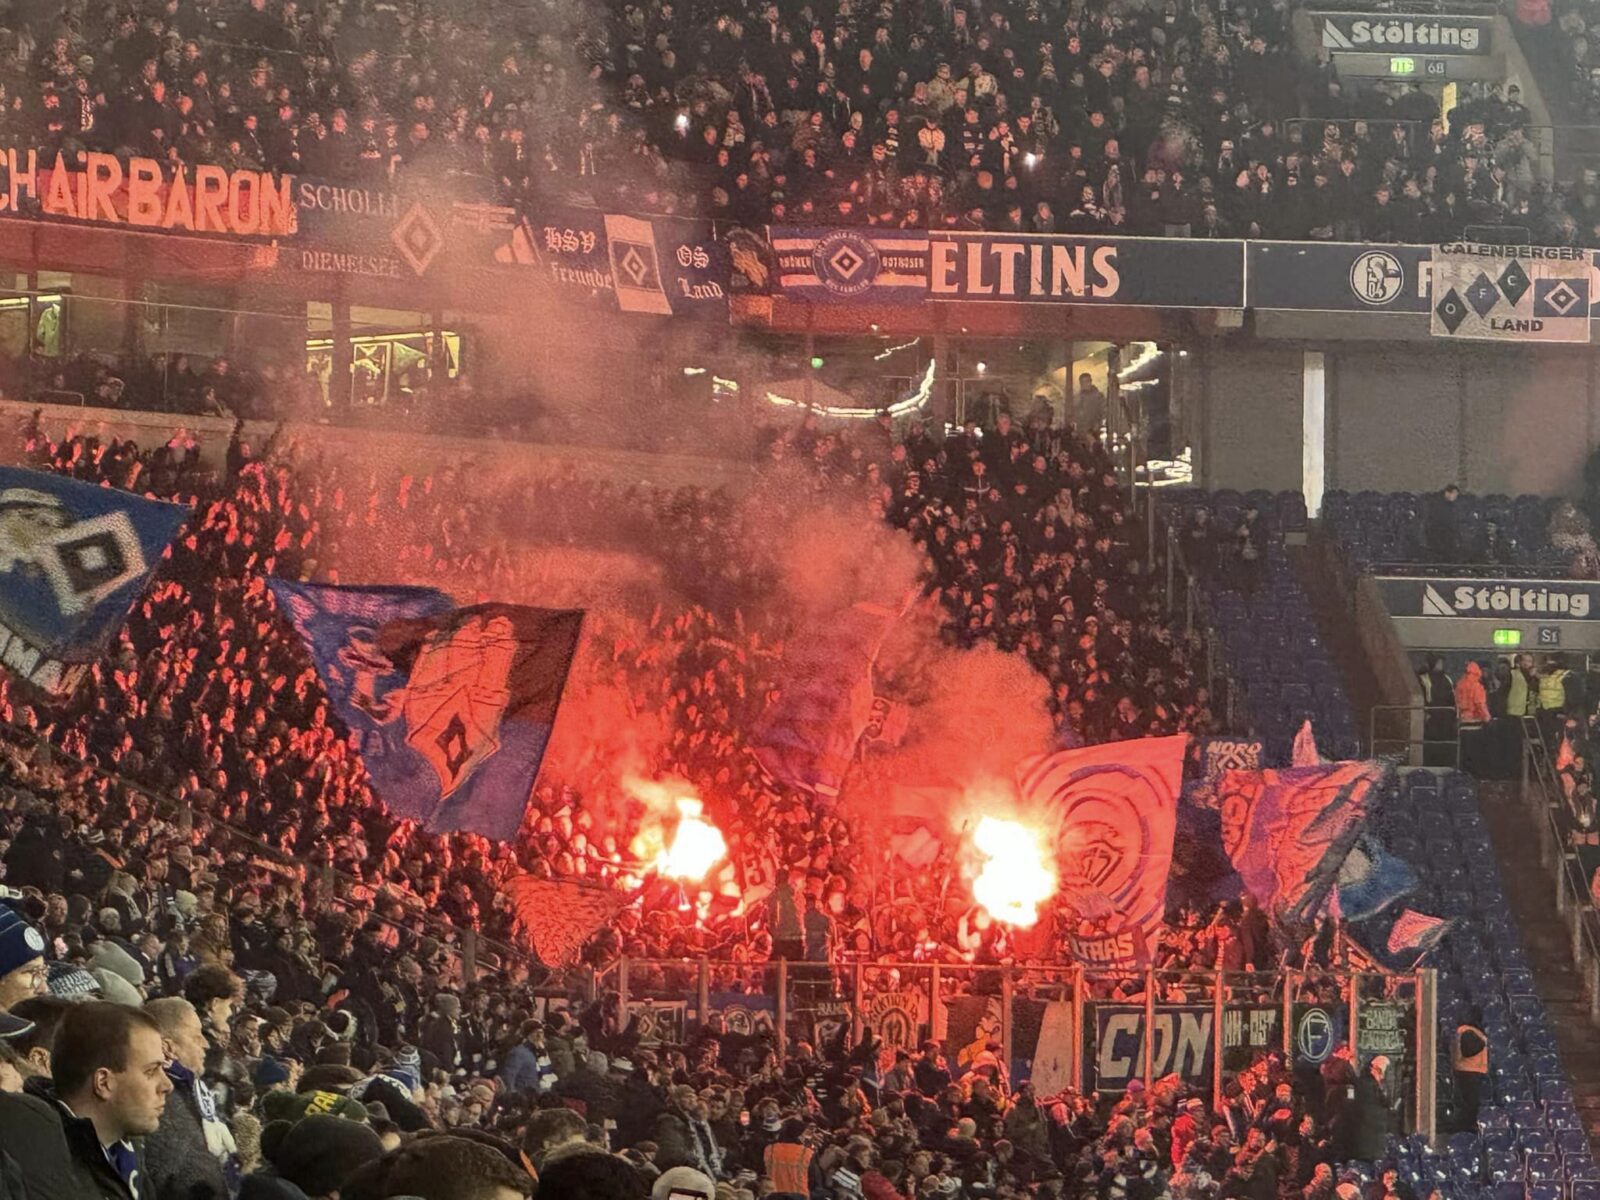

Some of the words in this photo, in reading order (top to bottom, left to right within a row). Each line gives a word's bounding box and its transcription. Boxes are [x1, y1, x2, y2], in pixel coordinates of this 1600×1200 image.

[1352, 20, 1479, 50] Stölting
[1439, 243, 1585, 261] CALENBERGER
[677, 277, 725, 300] Land
[1490, 318, 1544, 332] LAND
[1454, 585, 1590, 617] Stölting
